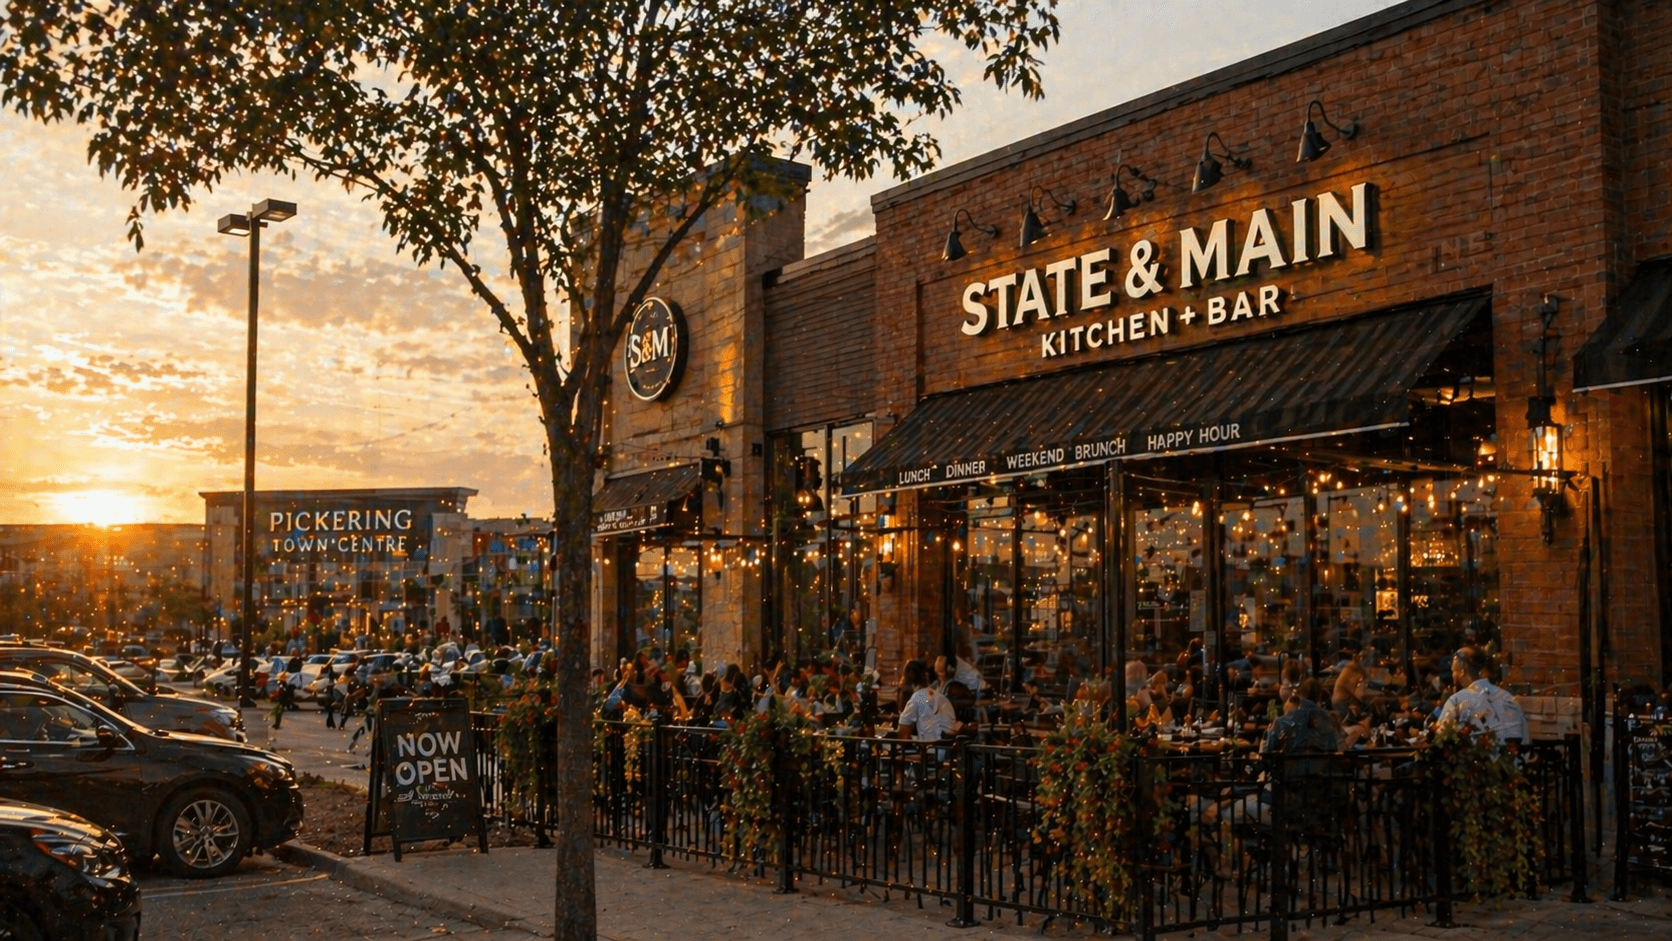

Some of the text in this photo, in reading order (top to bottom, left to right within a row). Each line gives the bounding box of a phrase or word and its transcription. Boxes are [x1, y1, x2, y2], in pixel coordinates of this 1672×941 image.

[961, 182, 1370, 336] STATE & MAIN
[1041, 284, 1281, 358] KITCHEN + BAR
[629, 326, 669, 368] S&M
[899, 468, 931, 485] LUNCH
[1006, 447, 1065, 470] WEEKEND
[1074, 439, 1126, 460] BRUNCH
[1147, 430, 1193, 451] HAPPY
[1199, 423, 1241, 443] HOUR
[269, 509, 412, 532] PICKERING
[273, 535, 407, 553] TOWN CENTRE
[397, 731, 461, 757] NOW
[395, 757, 468, 786] OPEN
